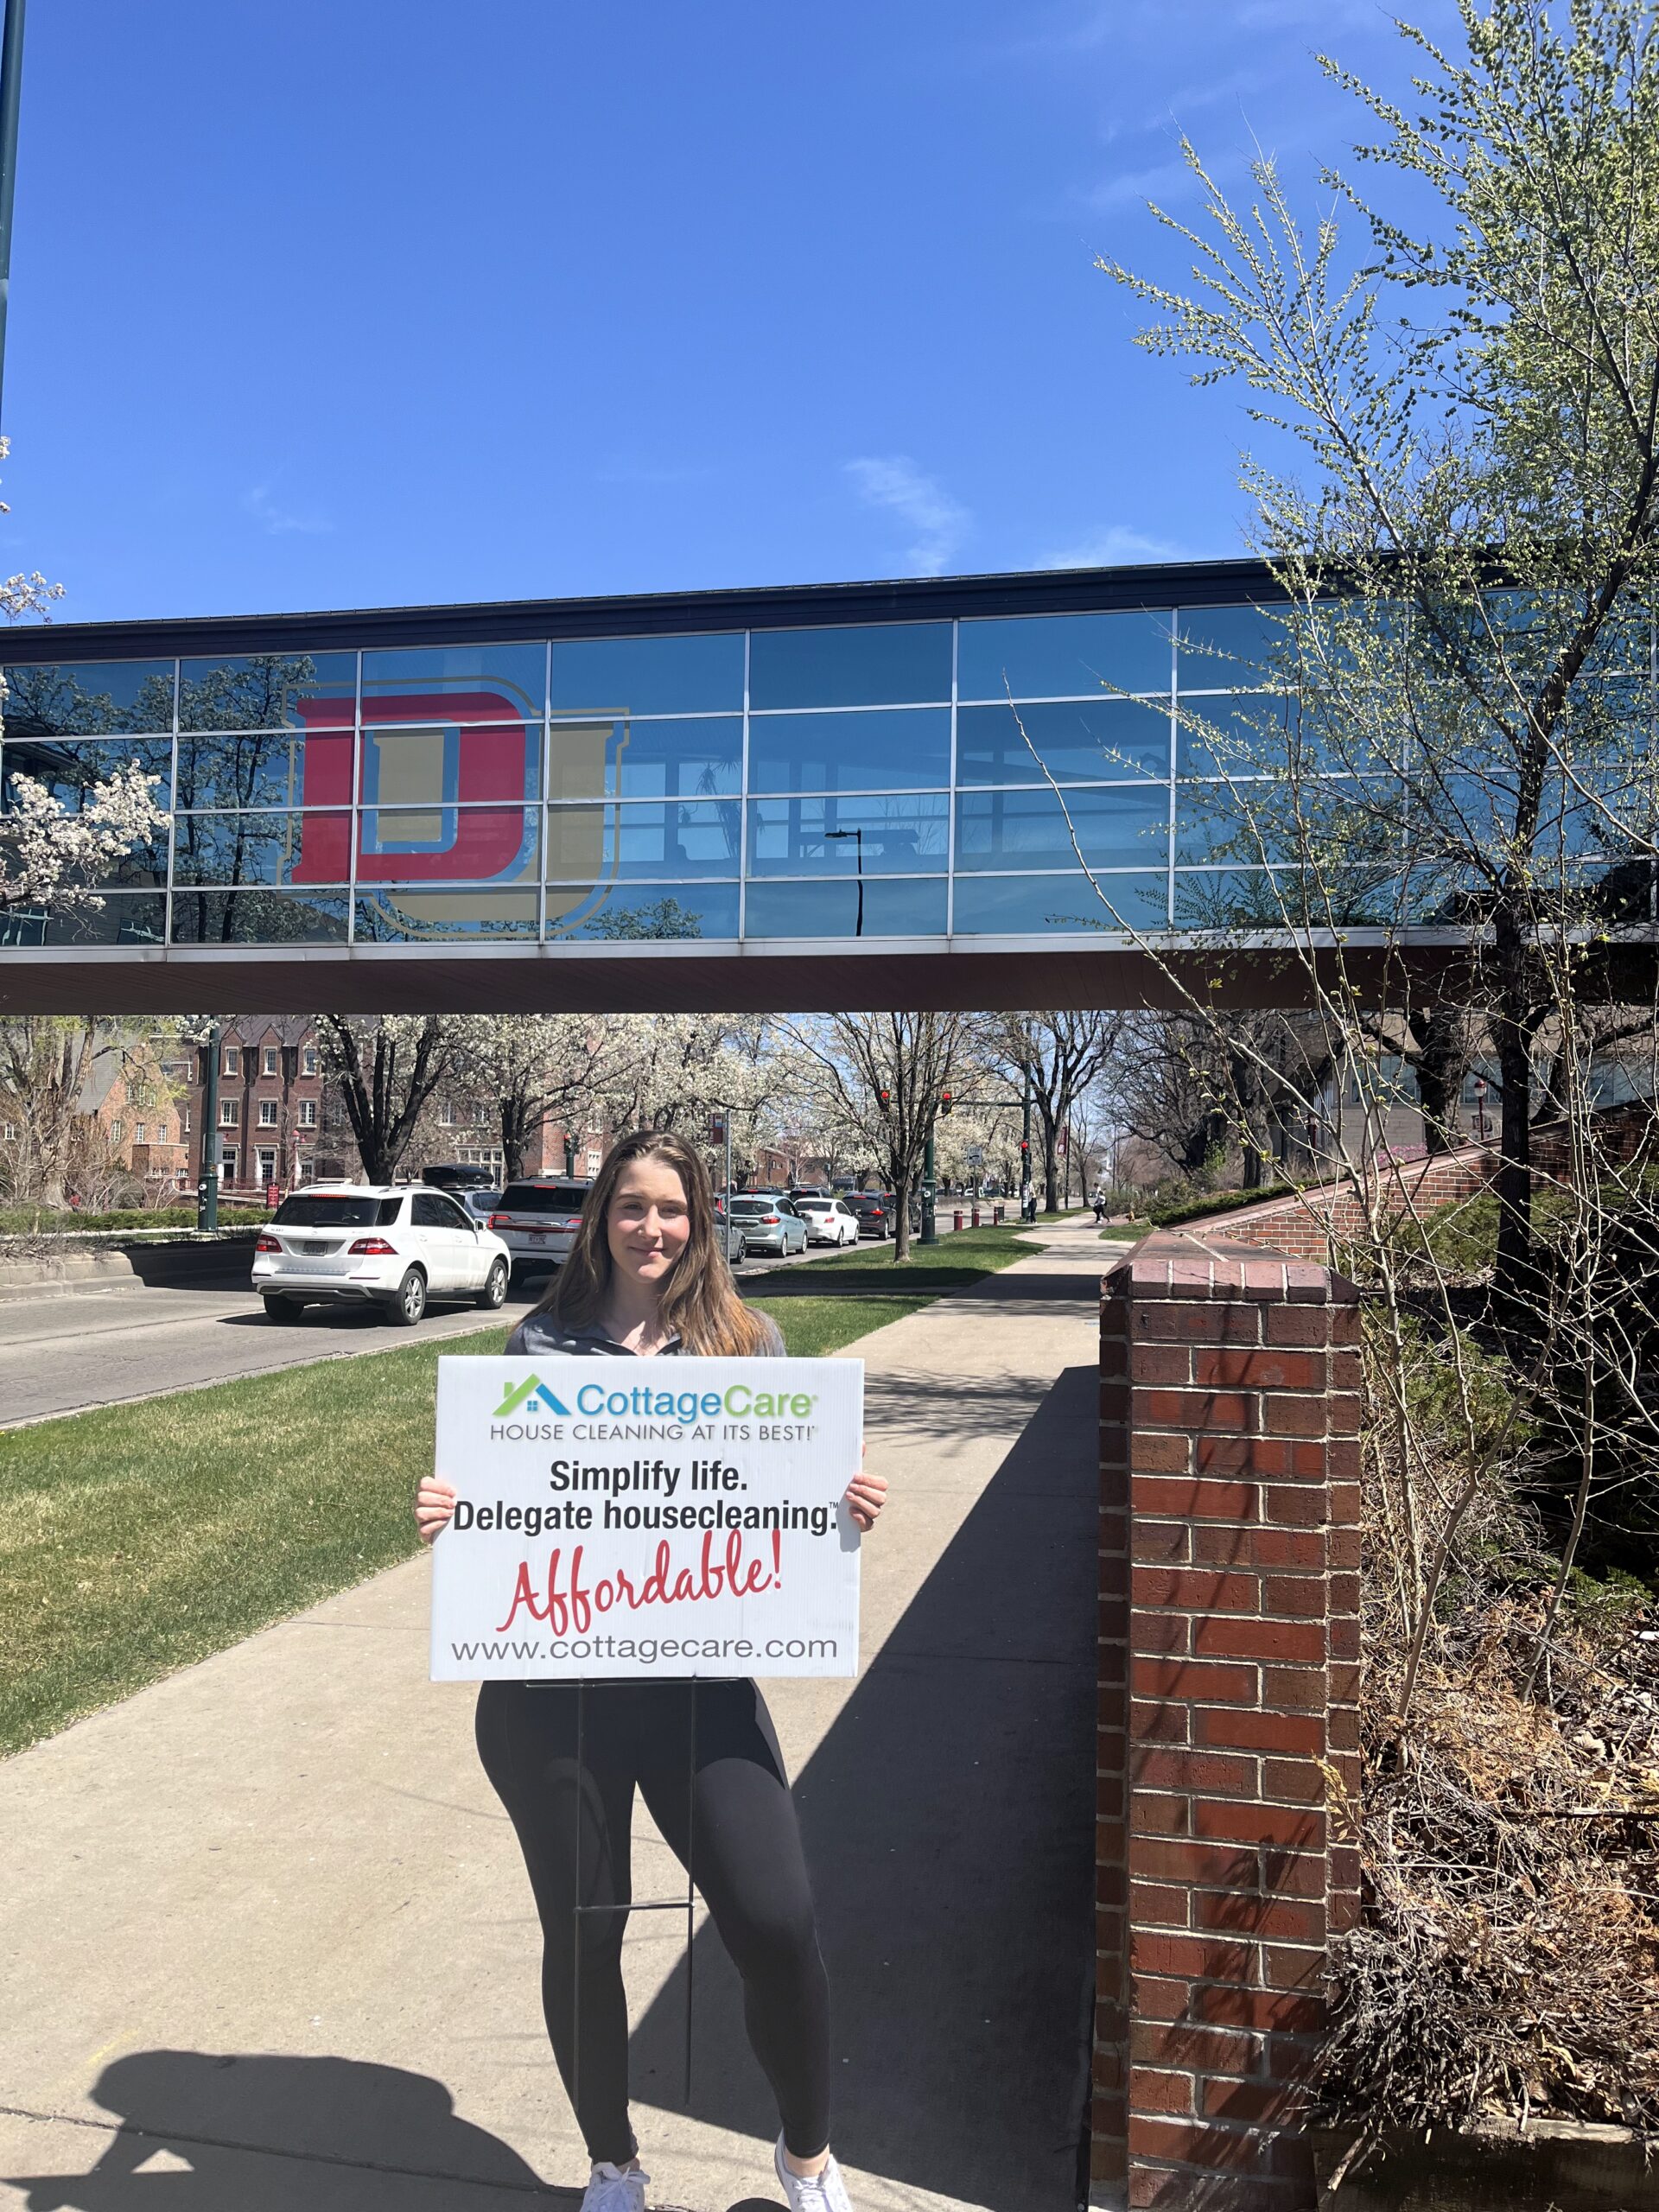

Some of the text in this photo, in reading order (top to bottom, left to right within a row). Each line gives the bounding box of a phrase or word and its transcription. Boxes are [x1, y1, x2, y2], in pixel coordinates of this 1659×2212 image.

[491, 1424, 812, 1441] HOUSE CLEANING AT ITS BEST!
[550, 1460, 748, 1497] Simplify life.
[454, 1500, 593, 1536] Delegate
[496, 1529, 782, 1637] Affordable!
[451, 1636, 837, 1664] www.cottagecare.com
